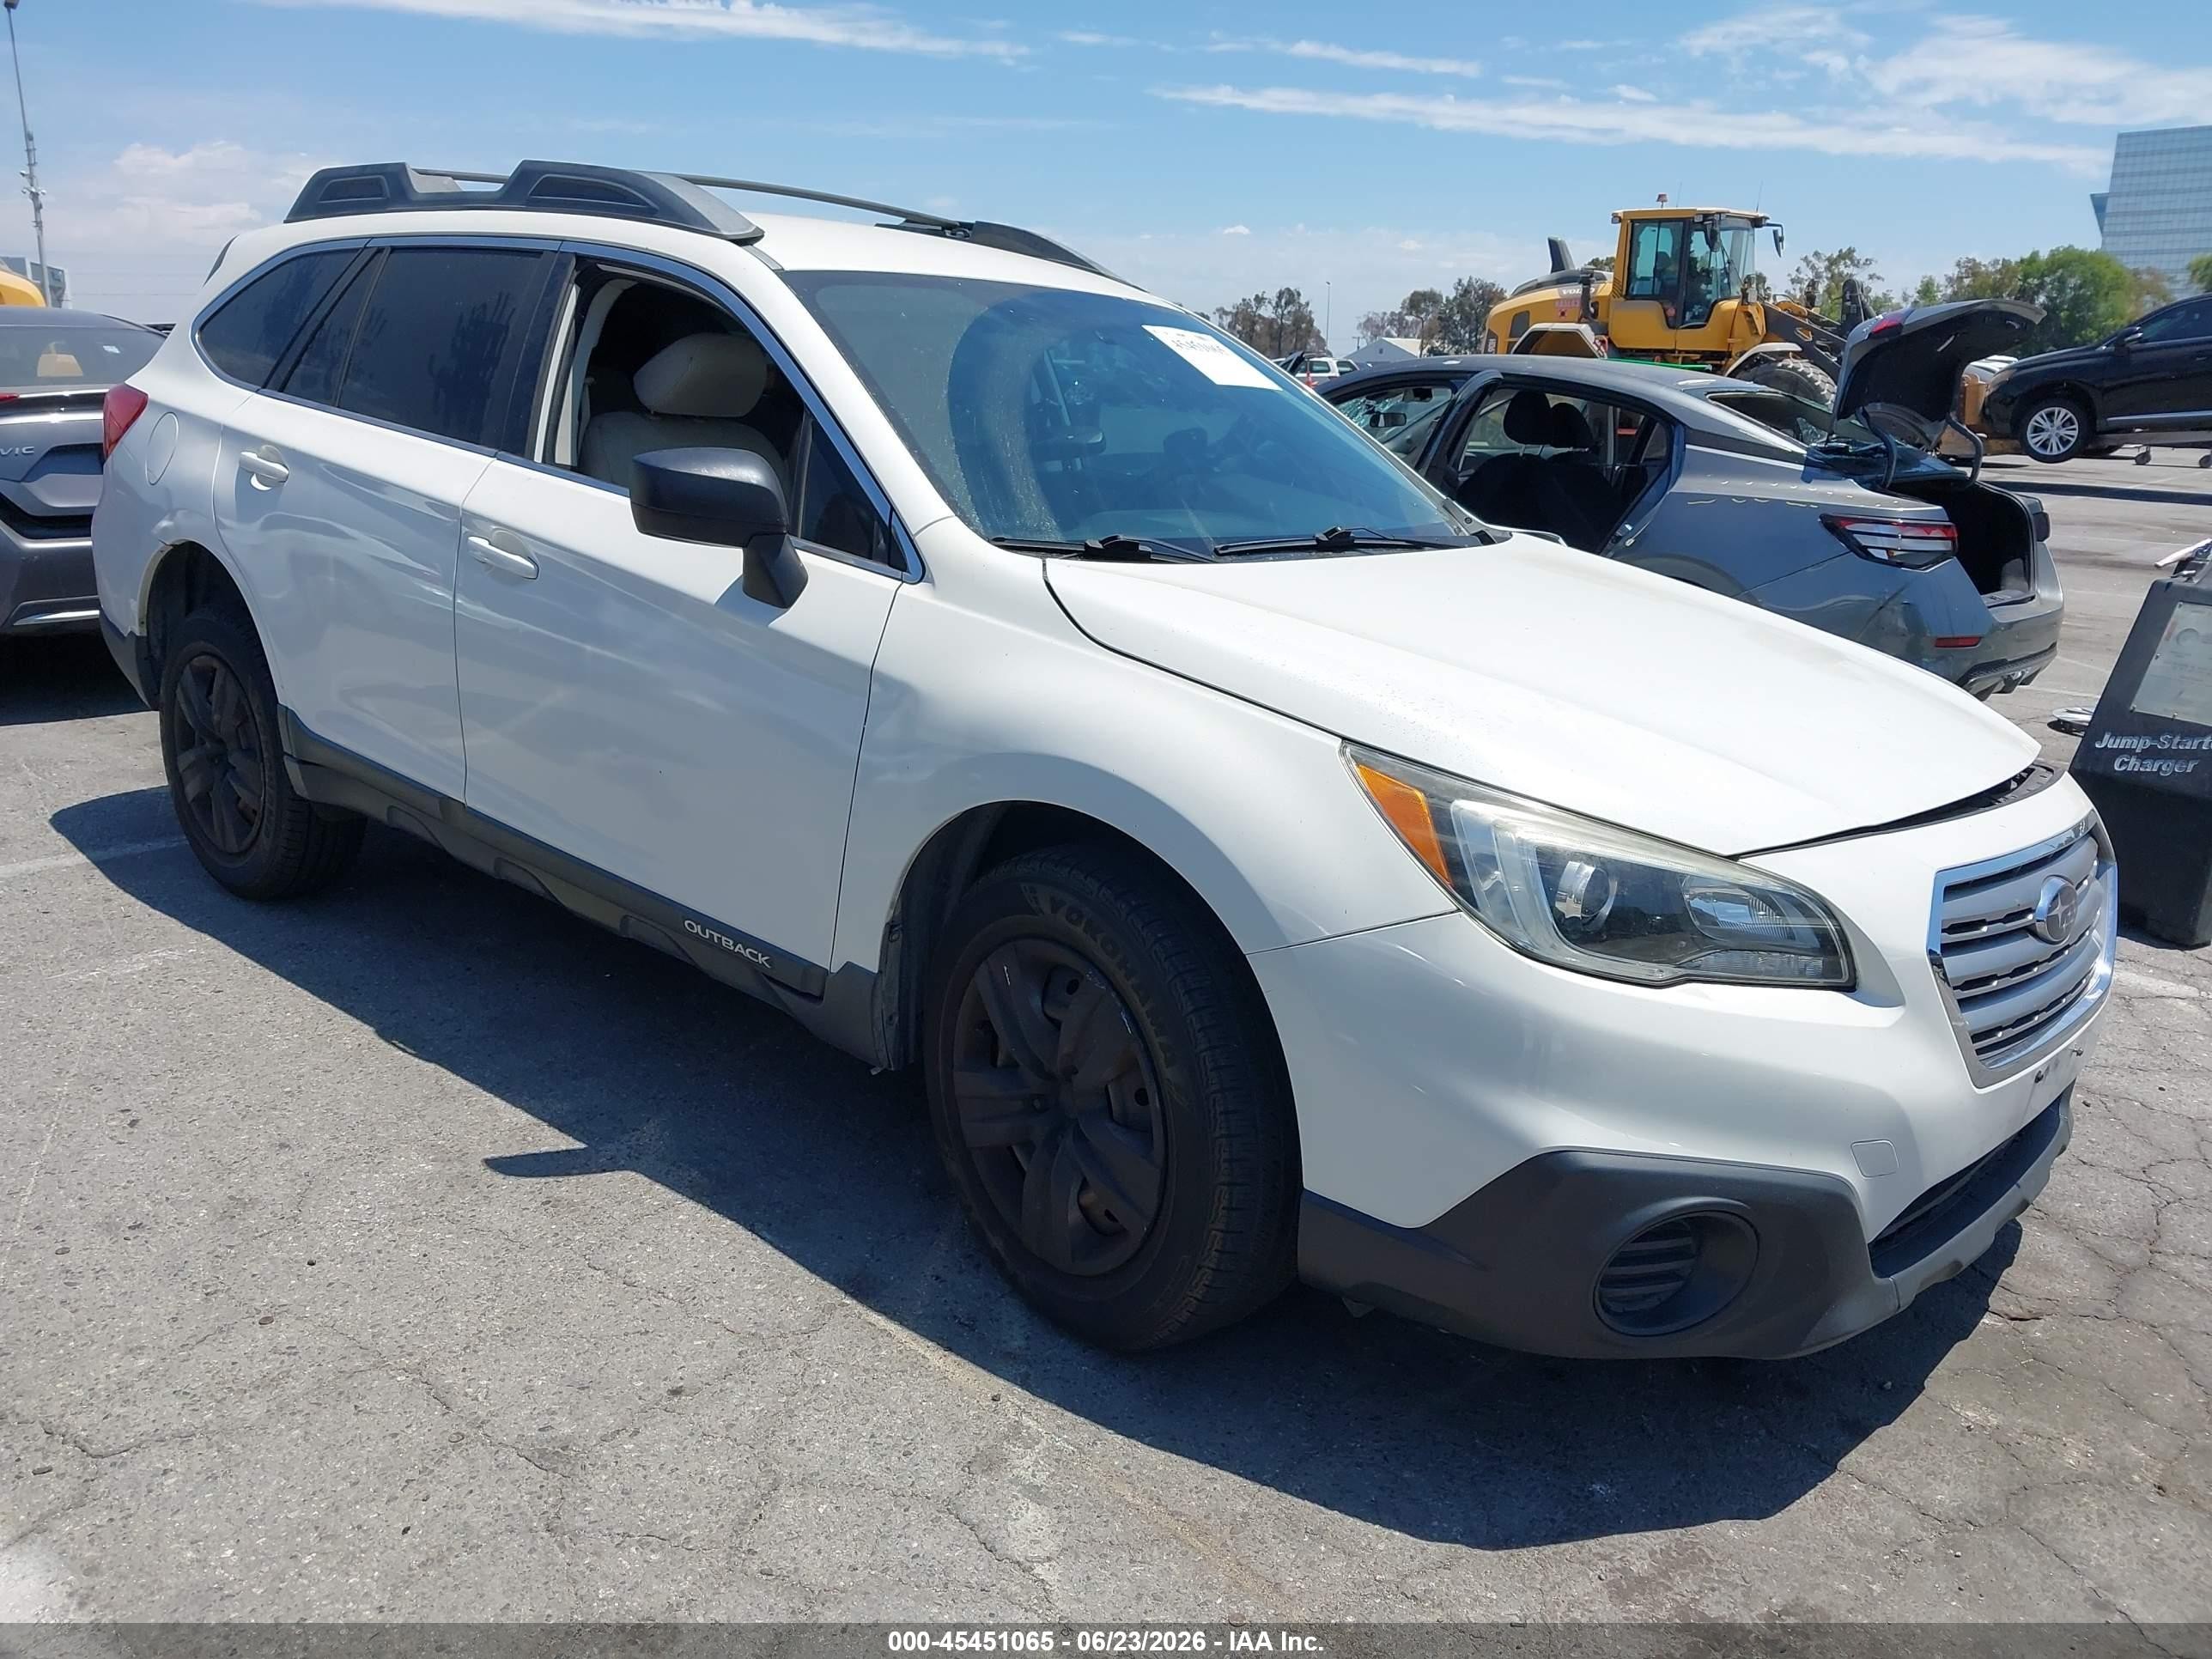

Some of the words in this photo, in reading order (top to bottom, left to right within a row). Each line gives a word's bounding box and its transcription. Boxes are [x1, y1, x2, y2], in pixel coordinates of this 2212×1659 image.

[1562, 286, 1596, 295] VOLO
[2094, 732, 2212, 752] Jump-Start
[2113, 755, 2199, 776] Charger
[684, 920, 771, 969] OUTBACK
